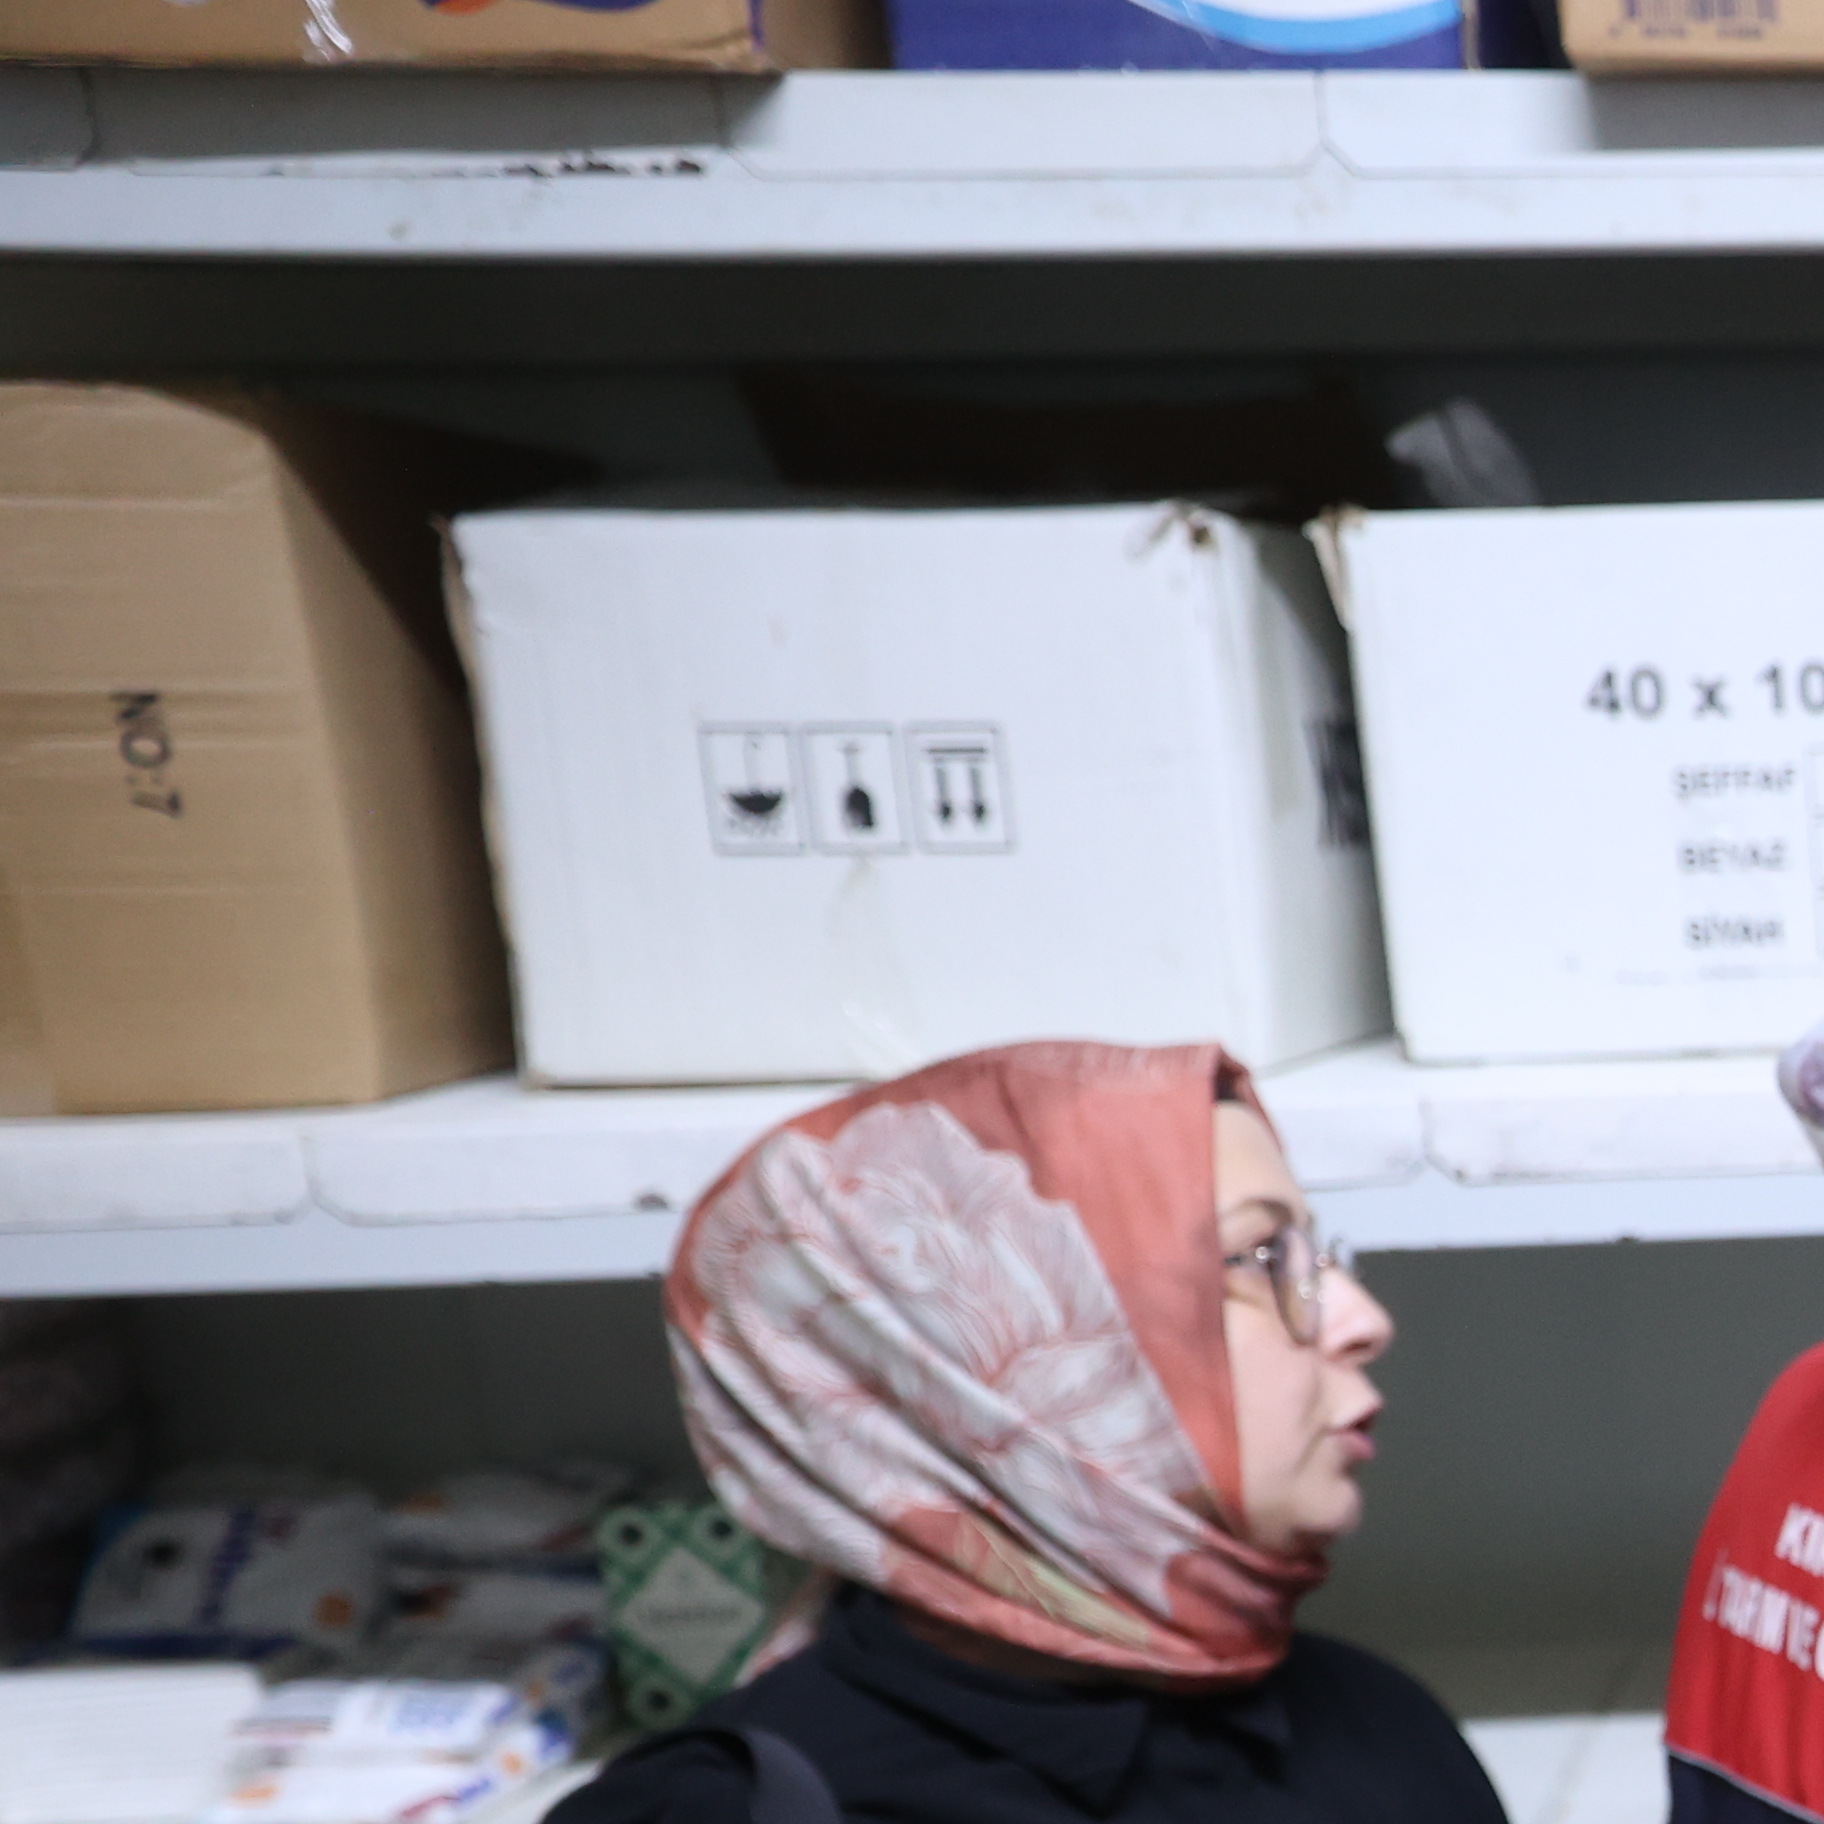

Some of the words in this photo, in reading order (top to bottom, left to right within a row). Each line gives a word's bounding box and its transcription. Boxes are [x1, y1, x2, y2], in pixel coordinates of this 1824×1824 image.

[1584, 660, 1667, 722] 40
[1691, 674, 1730, 718] x
[110, 690, 184, 819] NO:7
